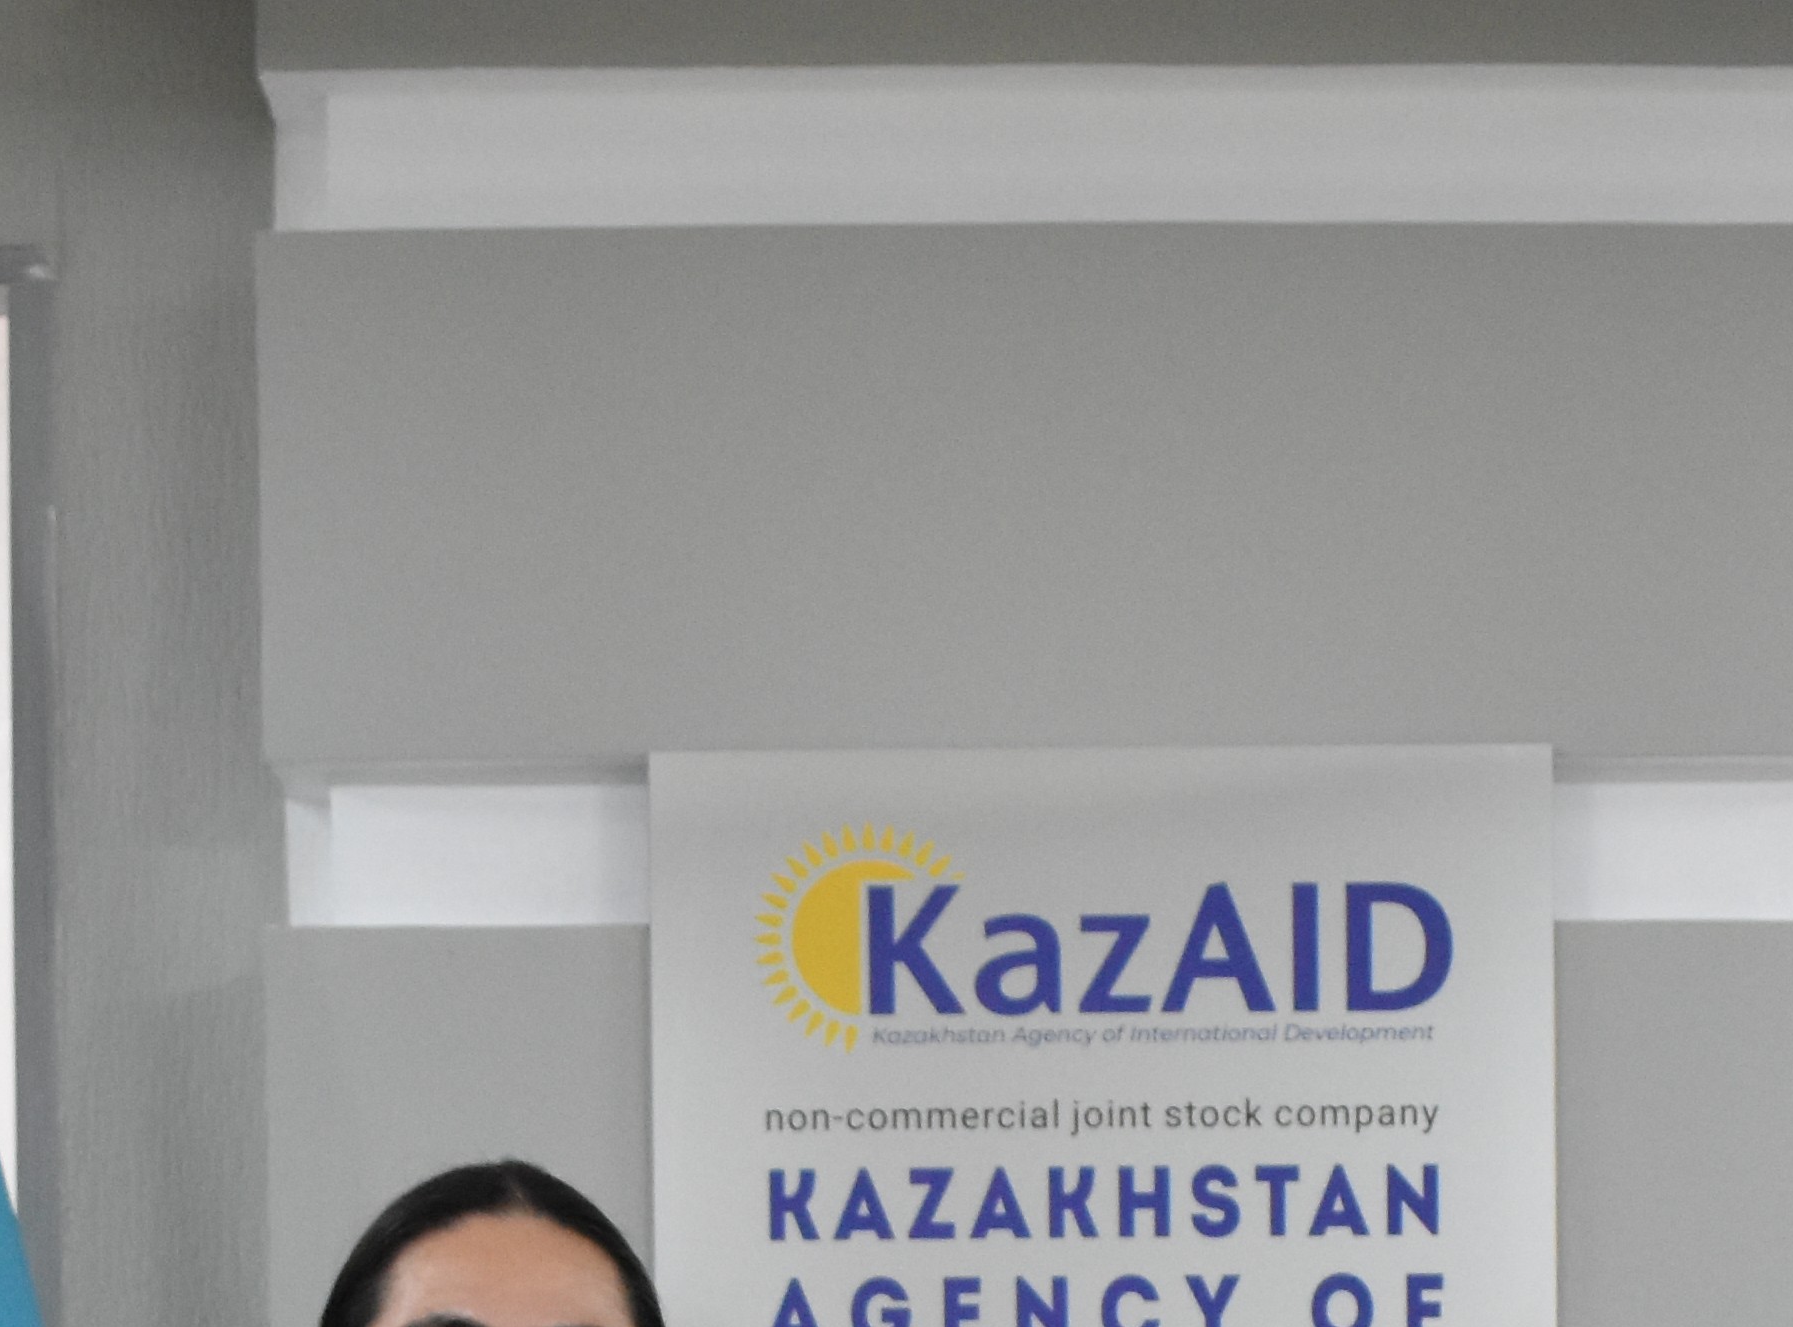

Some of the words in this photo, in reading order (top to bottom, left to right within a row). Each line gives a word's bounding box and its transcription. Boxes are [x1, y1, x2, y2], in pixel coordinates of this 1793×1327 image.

[866, 881, 1454, 1017] KazAID
[871, 1026, 1006, 1046] Kazakhstan
[1011, 1025, 1098, 1049] Agency
[1100, 1024, 1125, 1044] of
[1129, 1024, 1277, 1044] International
[1283, 1023, 1435, 1048] Development
[764, 1099, 1060, 1131] non-commercial
[1069, 1099, 1152, 1136] joint
[1164, 1098, 1264, 1129] stock
[1274, 1102, 1440, 1134] company
[768, 1163, 1441, 1241] KAZAKHSTAN
